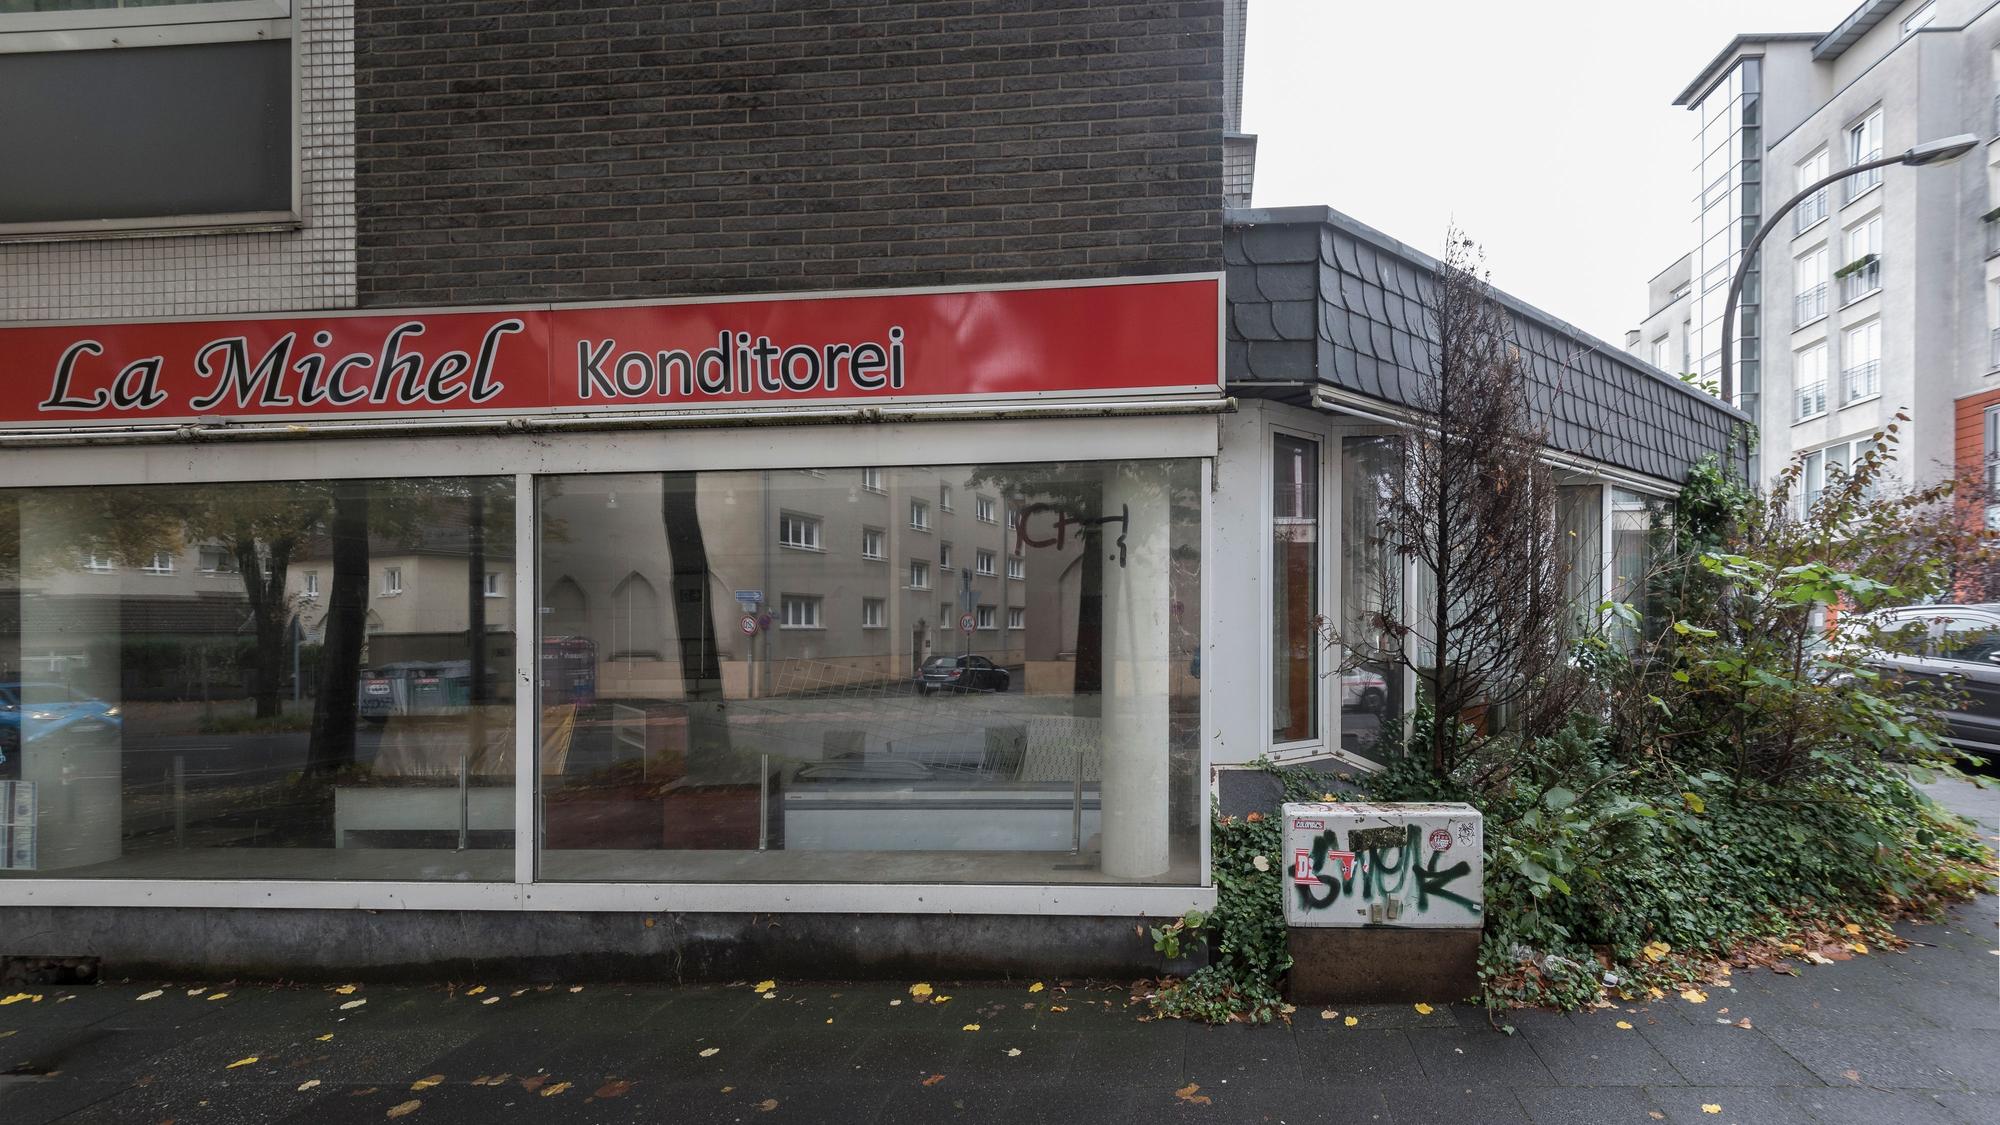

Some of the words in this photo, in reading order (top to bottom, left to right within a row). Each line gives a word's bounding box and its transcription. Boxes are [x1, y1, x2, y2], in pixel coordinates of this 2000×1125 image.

[38, 339, 168, 412] La
[189, 318, 525, 409] Michel
[577, 326, 904, 399] Konditorei
